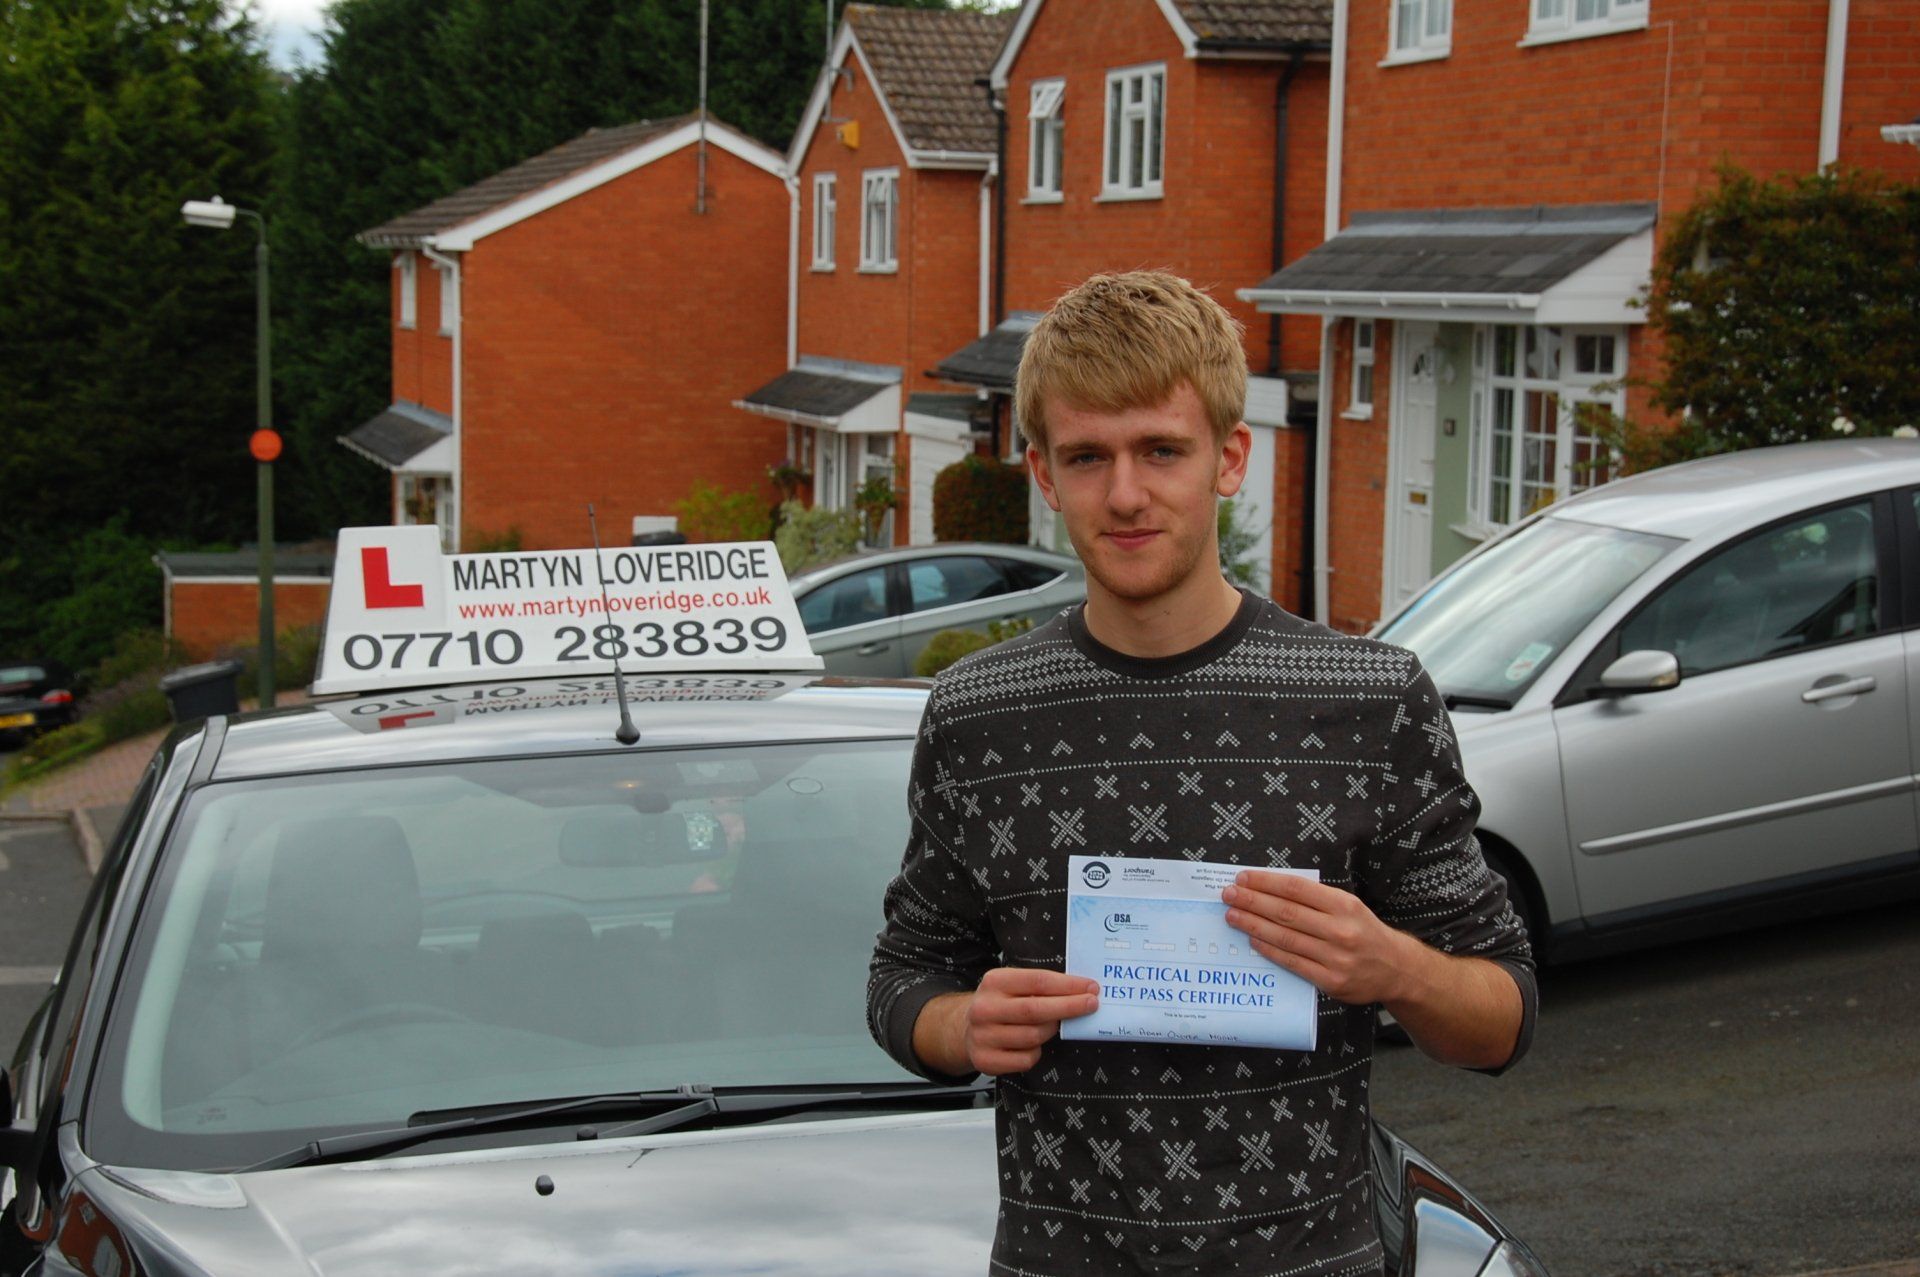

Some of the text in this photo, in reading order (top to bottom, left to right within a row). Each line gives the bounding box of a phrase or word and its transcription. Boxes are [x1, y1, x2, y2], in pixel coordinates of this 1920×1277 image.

[361, 547, 424, 609] L
[453, 549, 769, 591] MARTYN LOVERIDGE
[459, 586, 772, 619] www.martynloveridge.co.uk
[343, 617, 787, 670] 07710 283839
[1114, 913, 1131, 923] DSA
[1103, 964, 1275, 988] PRACTICAL DRIVING
[1103, 985, 1274, 1007] TEST PASS CERTIFICATE
